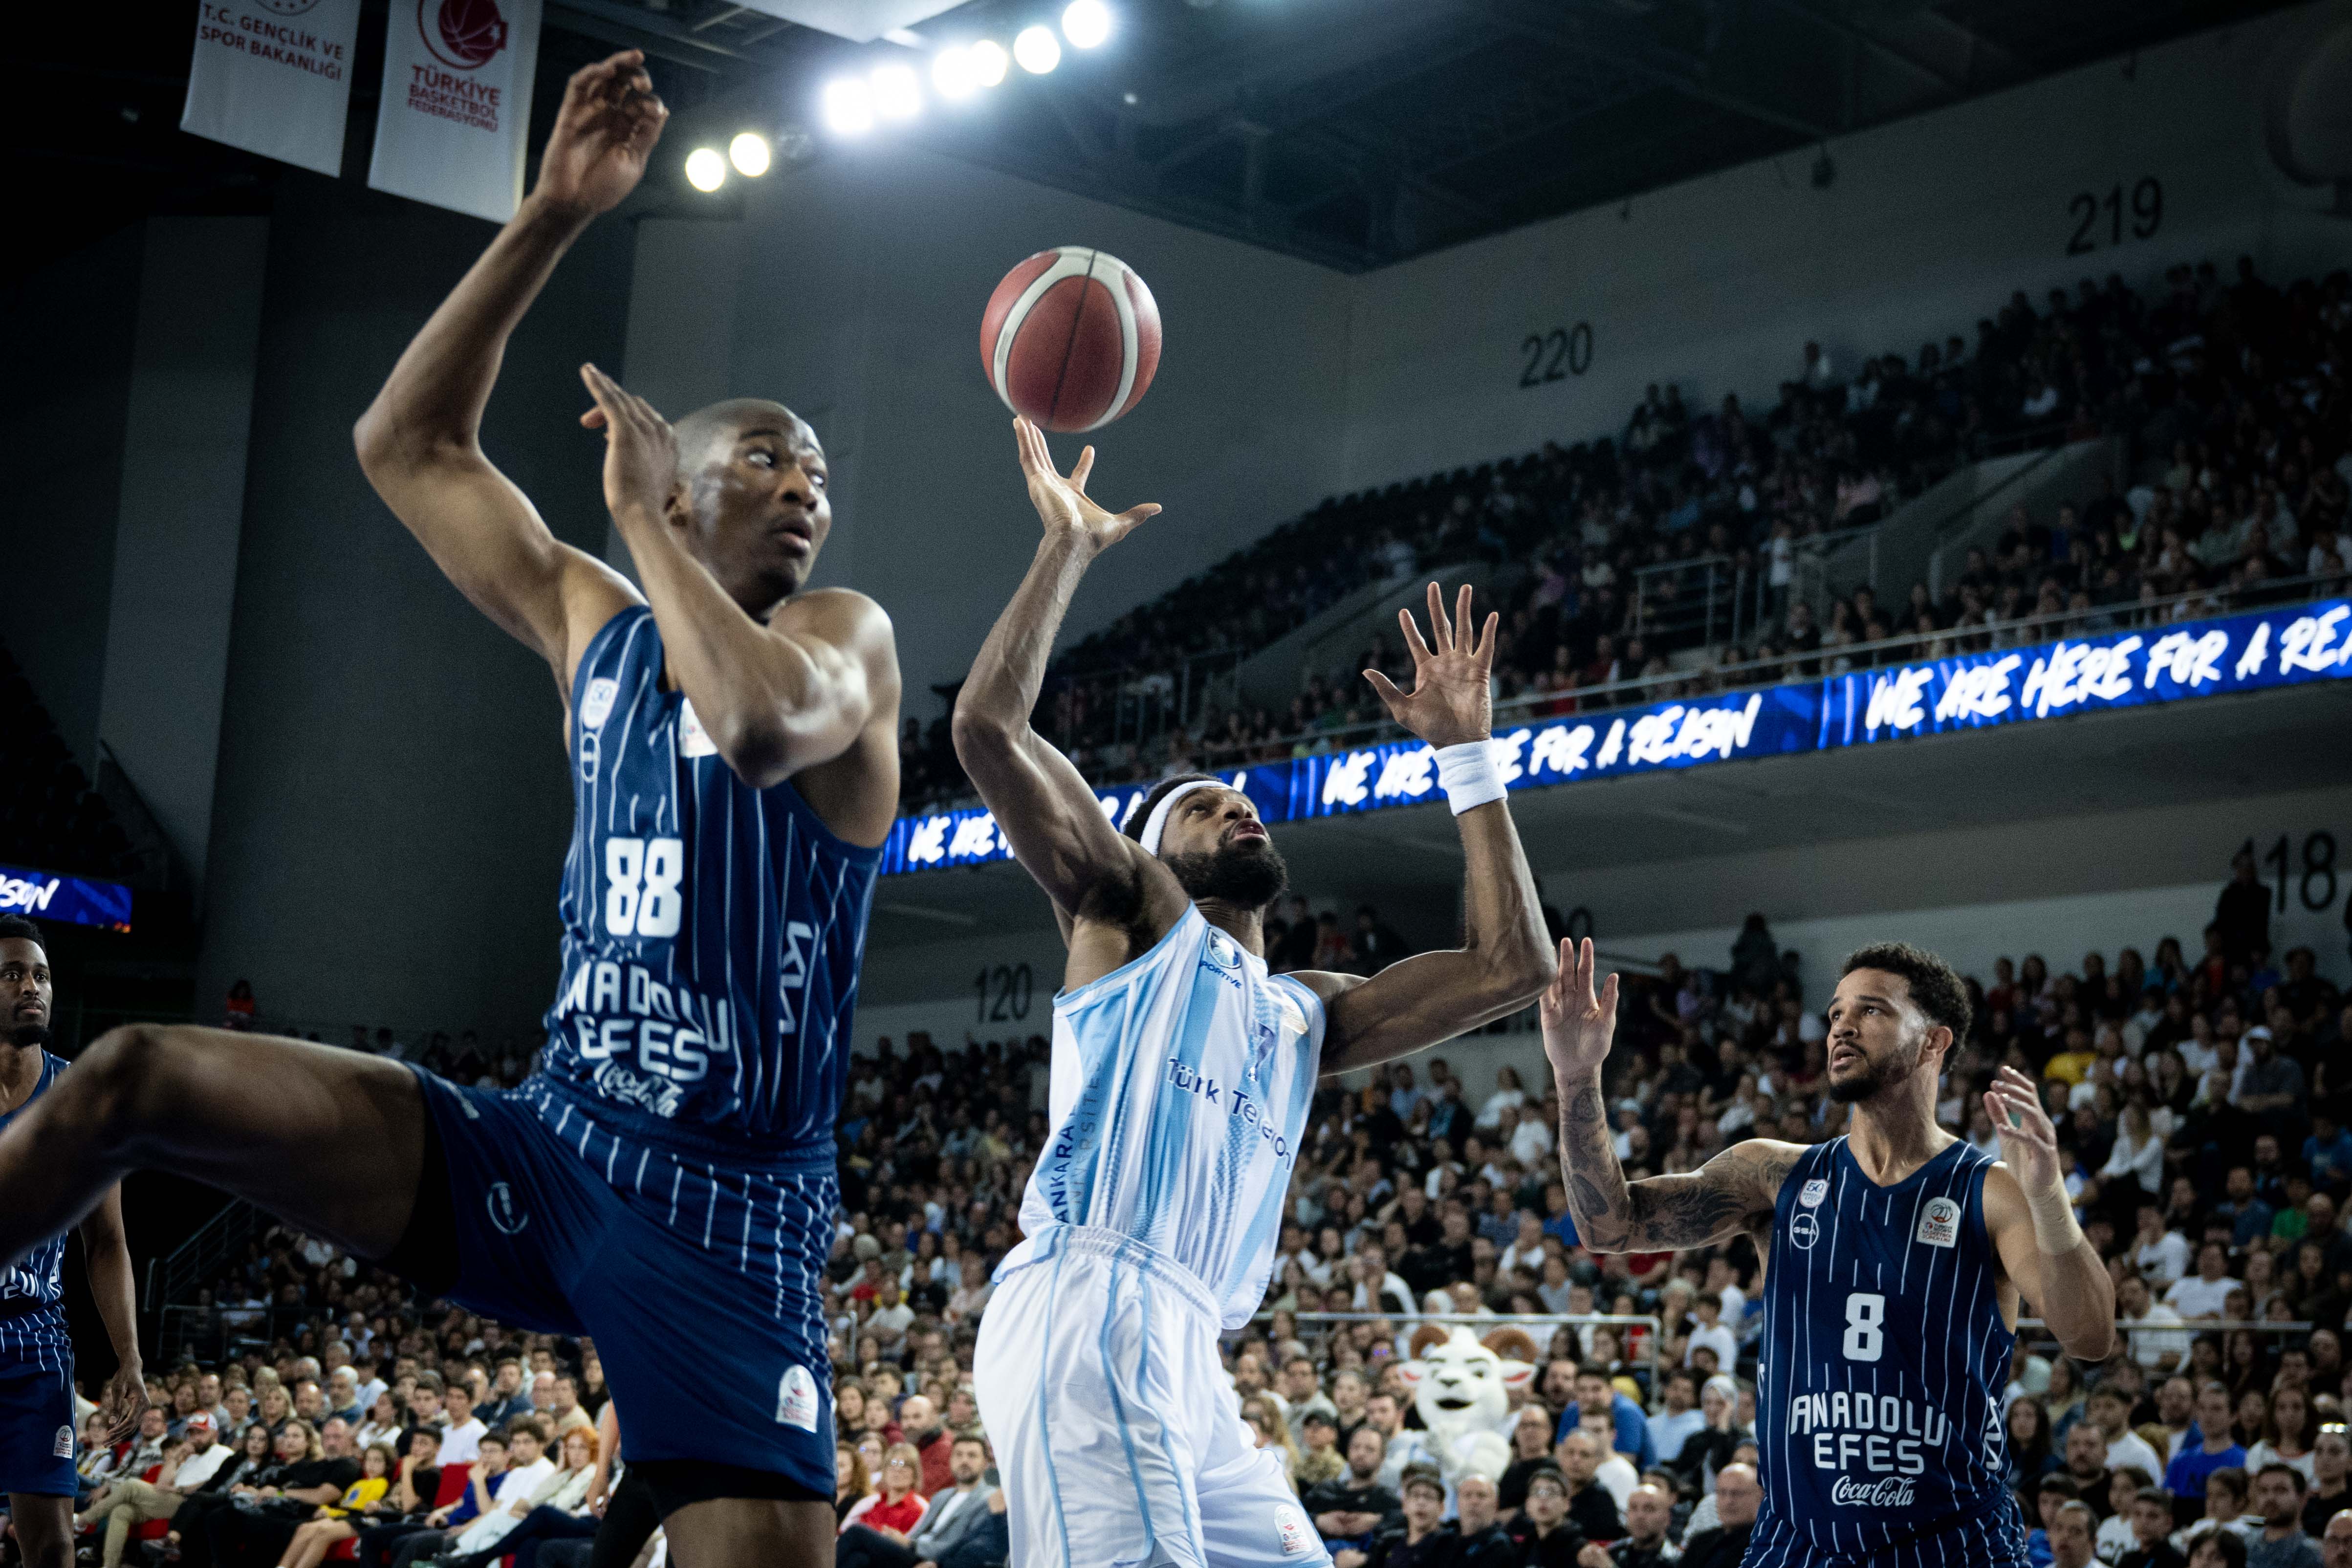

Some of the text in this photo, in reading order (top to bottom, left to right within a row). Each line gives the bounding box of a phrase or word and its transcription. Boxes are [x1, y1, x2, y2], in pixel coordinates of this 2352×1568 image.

[200, 25, 244, 52] SPOR
[323, 40, 343, 60] VE
[412, 64, 500, 107] TÜRKİYE
[2067, 177, 2161, 255] 219
[1520, 322, 1592, 390] 220
[1865, 667, 1935, 729] WE
[1935, 654, 2023, 722] ARE
[2021, 635, 2143, 719] HERE
[2144, 630, 2229, 689] FOR
[2235, 621, 2272, 681] A
[1322, 752, 1377, 806] WE
[1373, 744, 1436, 800] ARE
[1529, 724, 1595, 776] FOR
[1596, 718, 1627, 769] A
[1630, 691, 1764, 766] REASON
[908, 816, 952, 863] WE
[948, 811, 996, 859] ARE
[606, 836, 683, 939] 88
[2242, 832, 2335, 913] 18
[975, 963, 1032, 1024] 120
[574, 1014, 709, 1081] EFES
[1167, 1058, 1220, 1105] Türk
[1050, 1124, 1078, 1224] ANKARA
[1843, 1292, 1886, 1363] 8
[1790, 1391, 1946, 1447] ANADOLU
[1814, 1433, 1925, 1475] EFES
